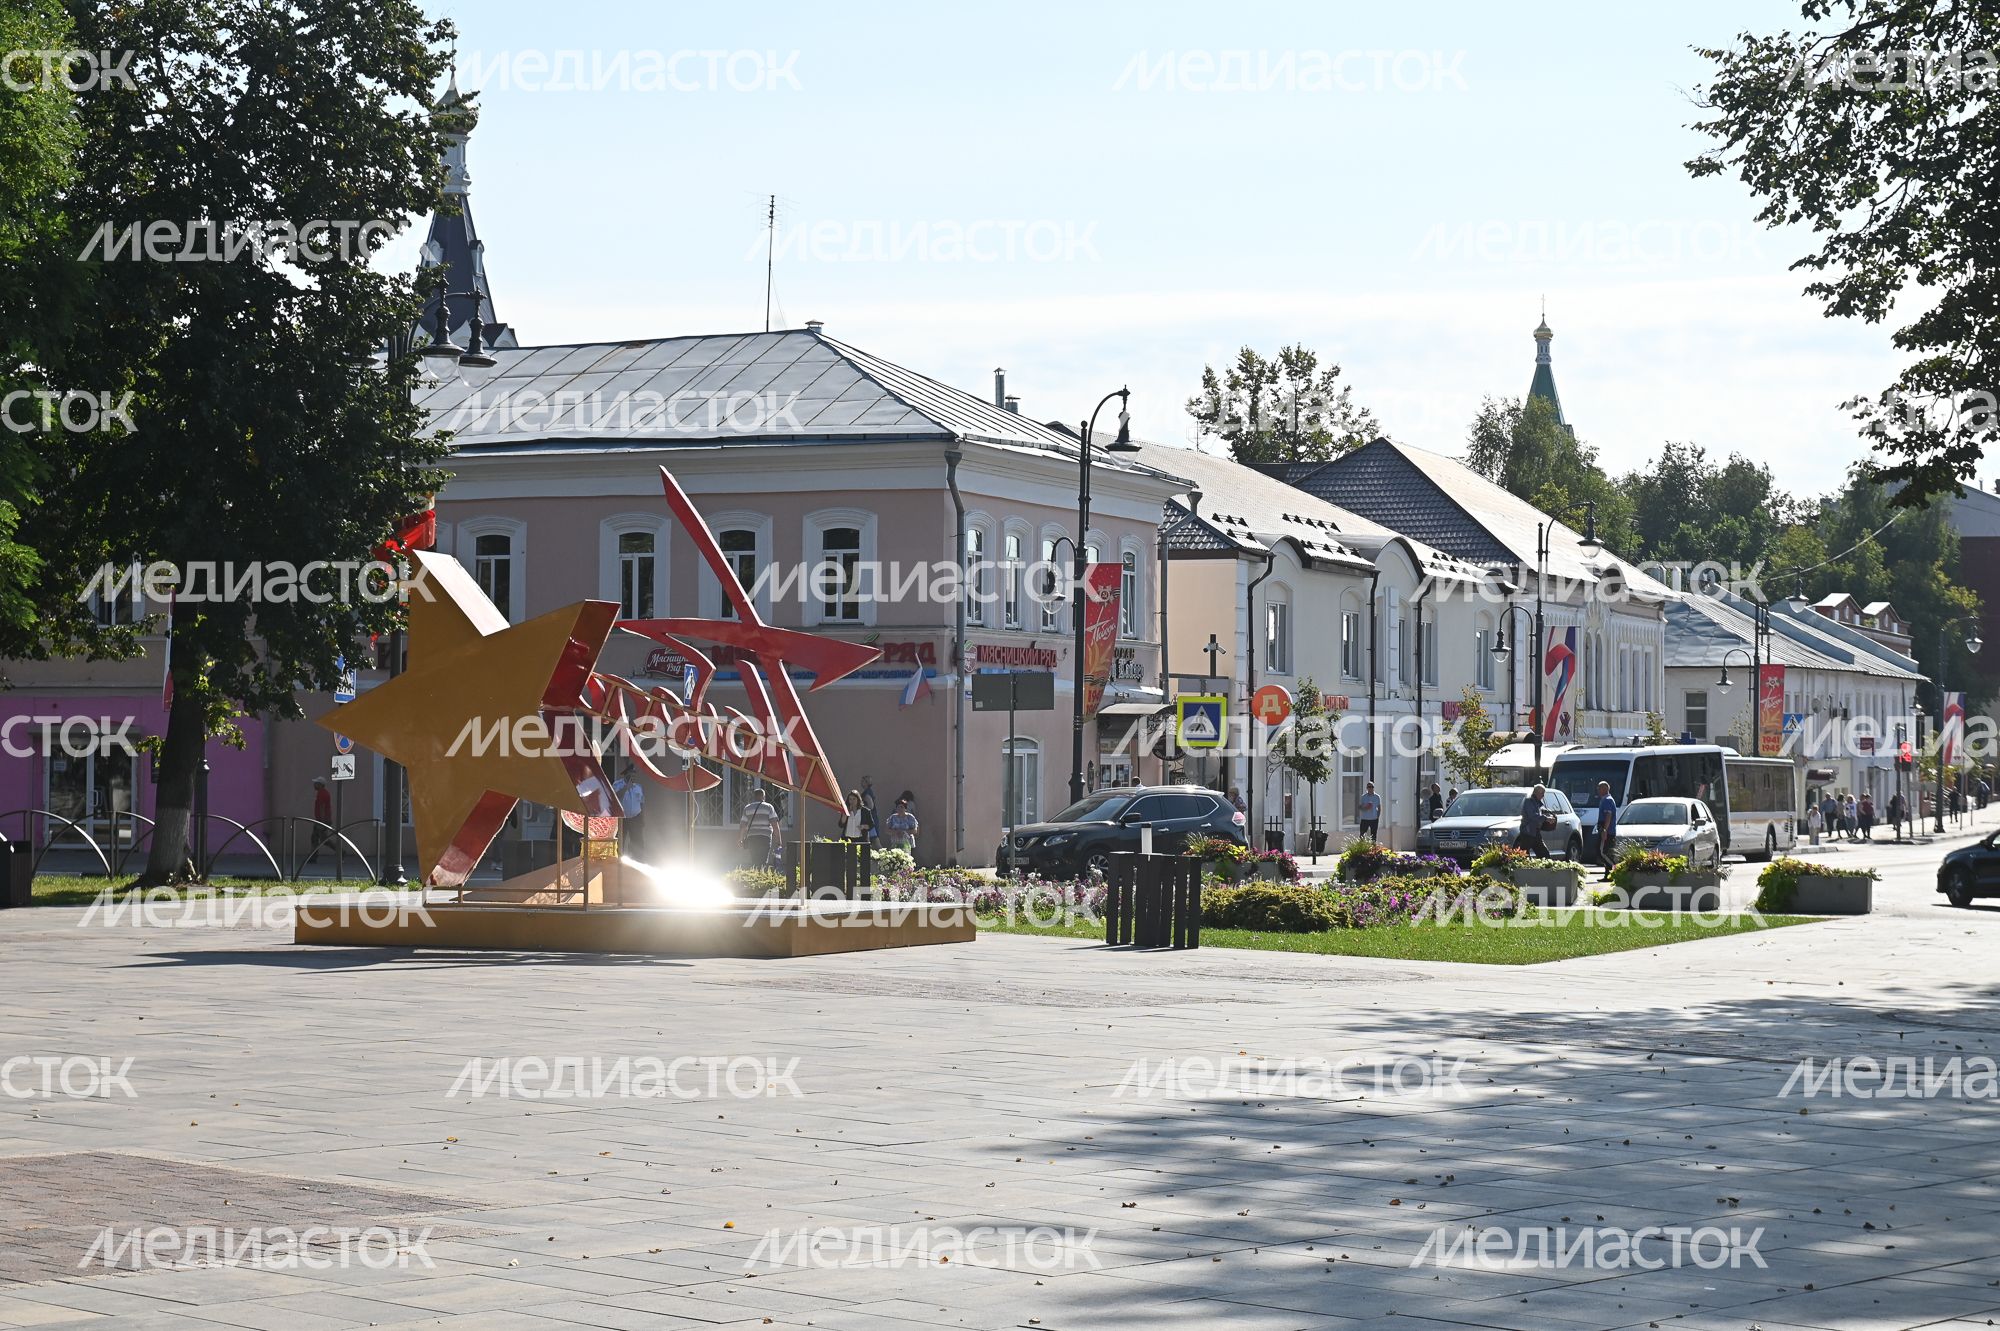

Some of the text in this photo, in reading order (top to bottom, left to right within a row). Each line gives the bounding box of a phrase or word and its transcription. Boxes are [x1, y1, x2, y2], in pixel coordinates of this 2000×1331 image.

[1040, 649, 1058, 667] РЯД
[1260, 694, 1282, 716] Д
[1762, 735, 1780, 744] 1941
[1761, 744, 1781, 752] 1945
